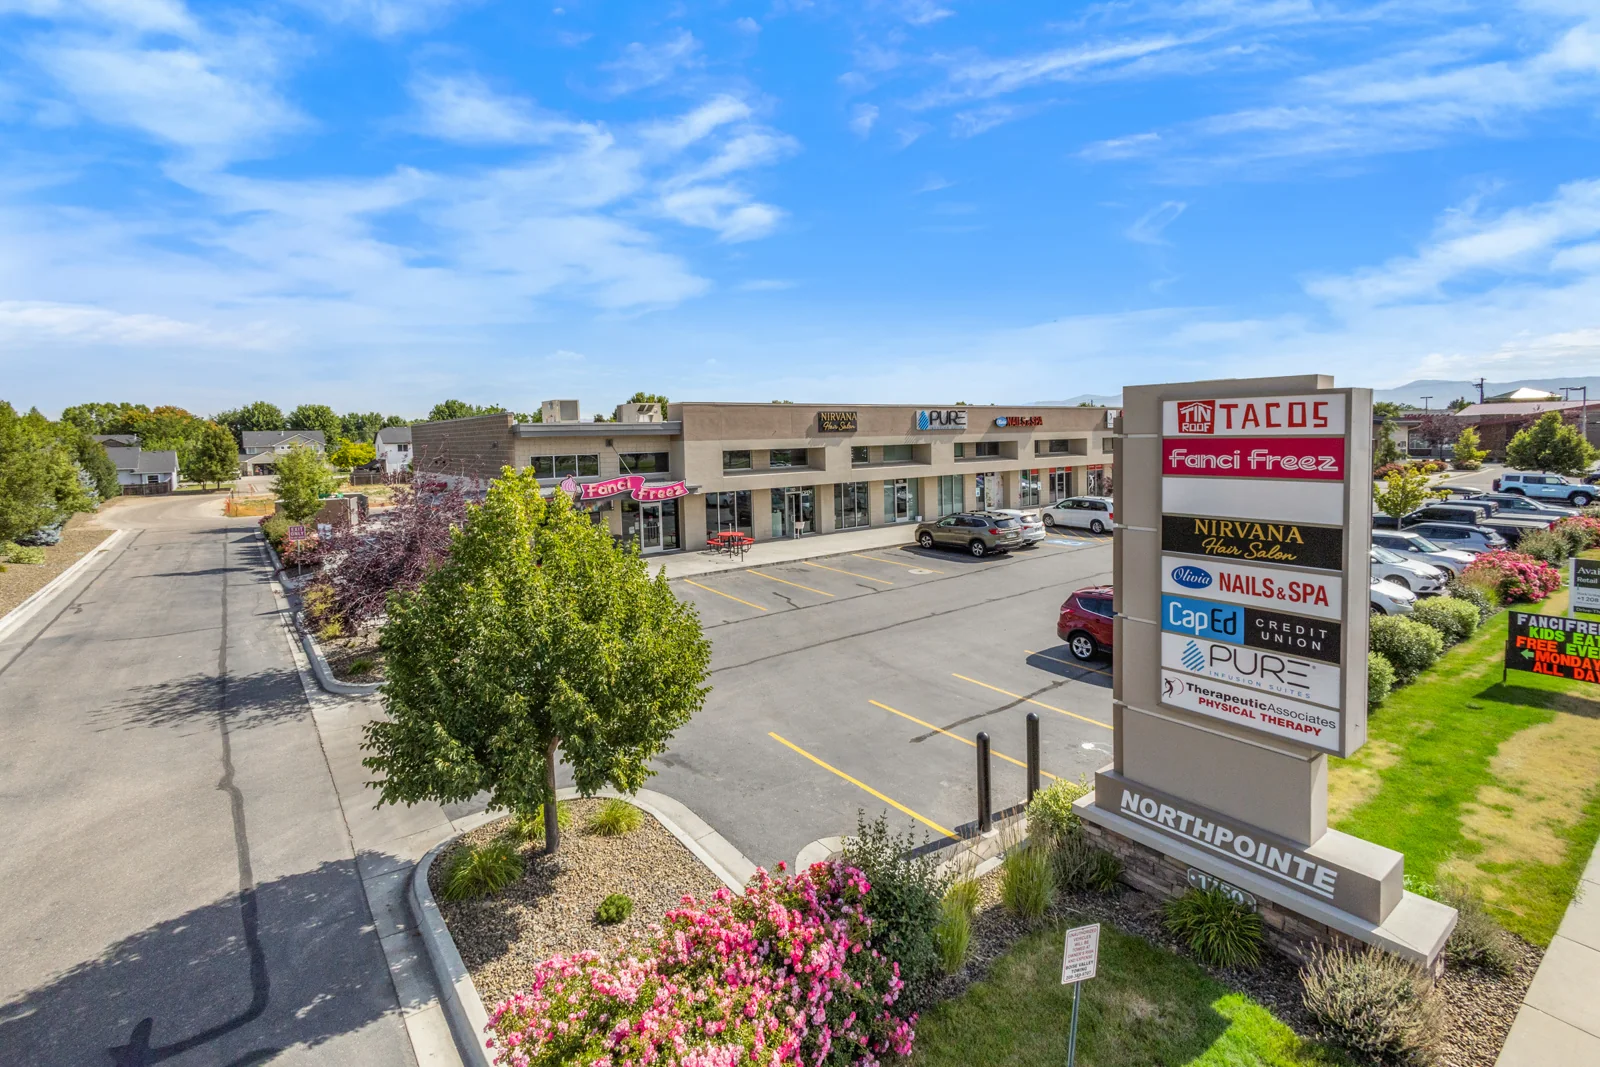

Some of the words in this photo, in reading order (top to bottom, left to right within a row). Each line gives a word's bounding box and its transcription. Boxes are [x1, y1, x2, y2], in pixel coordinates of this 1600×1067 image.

[821, 412, 858, 421] NIRVANA
[930, 410, 966, 426] PURE
[1180, 402, 1212, 423] TIN
[1220, 402, 1328, 430] TACOS
[823, 421, 838, 430] Hair
[838, 422, 855, 430] Salon
[1182, 422, 1212, 432] ROOF
[1168, 448, 1240, 470] fanci
[1248, 449, 1338, 472] freez
[587, 476, 632, 497] Fanci
[638, 485, 684, 500] Freez
[1194, 518, 1304, 544] NIRVANA
[1202, 538, 1242, 554] Hair
[1244, 542, 1296, 560] Salon
[1173, 568, 1211, 585] Olivia
[1170, 602, 1236, 636] CapEd
[1256, 618, 1328, 639] CREDIT
[1566, 620, 1600, 636] FRE
[1261, 631, 1321, 651] UNION
[1529, 626, 1566, 642] KIDS
[1516, 636, 1558, 653] FREE
[1566, 643, 1600, 659] EVE
[1210, 644, 1310, 690] PURE
[1533, 662, 1564, 677] ALL
[1535, 650, 1600, 671] MONDAY
[1209, 671, 1262, 687] INFUSION
[1269, 684, 1311, 699] SUITES
[1198, 697, 1256, 720] PHYSICAL
[1260, 713, 1322, 737] THERAPY
[1120, 790, 1338, 893] NORTHPOINTE
